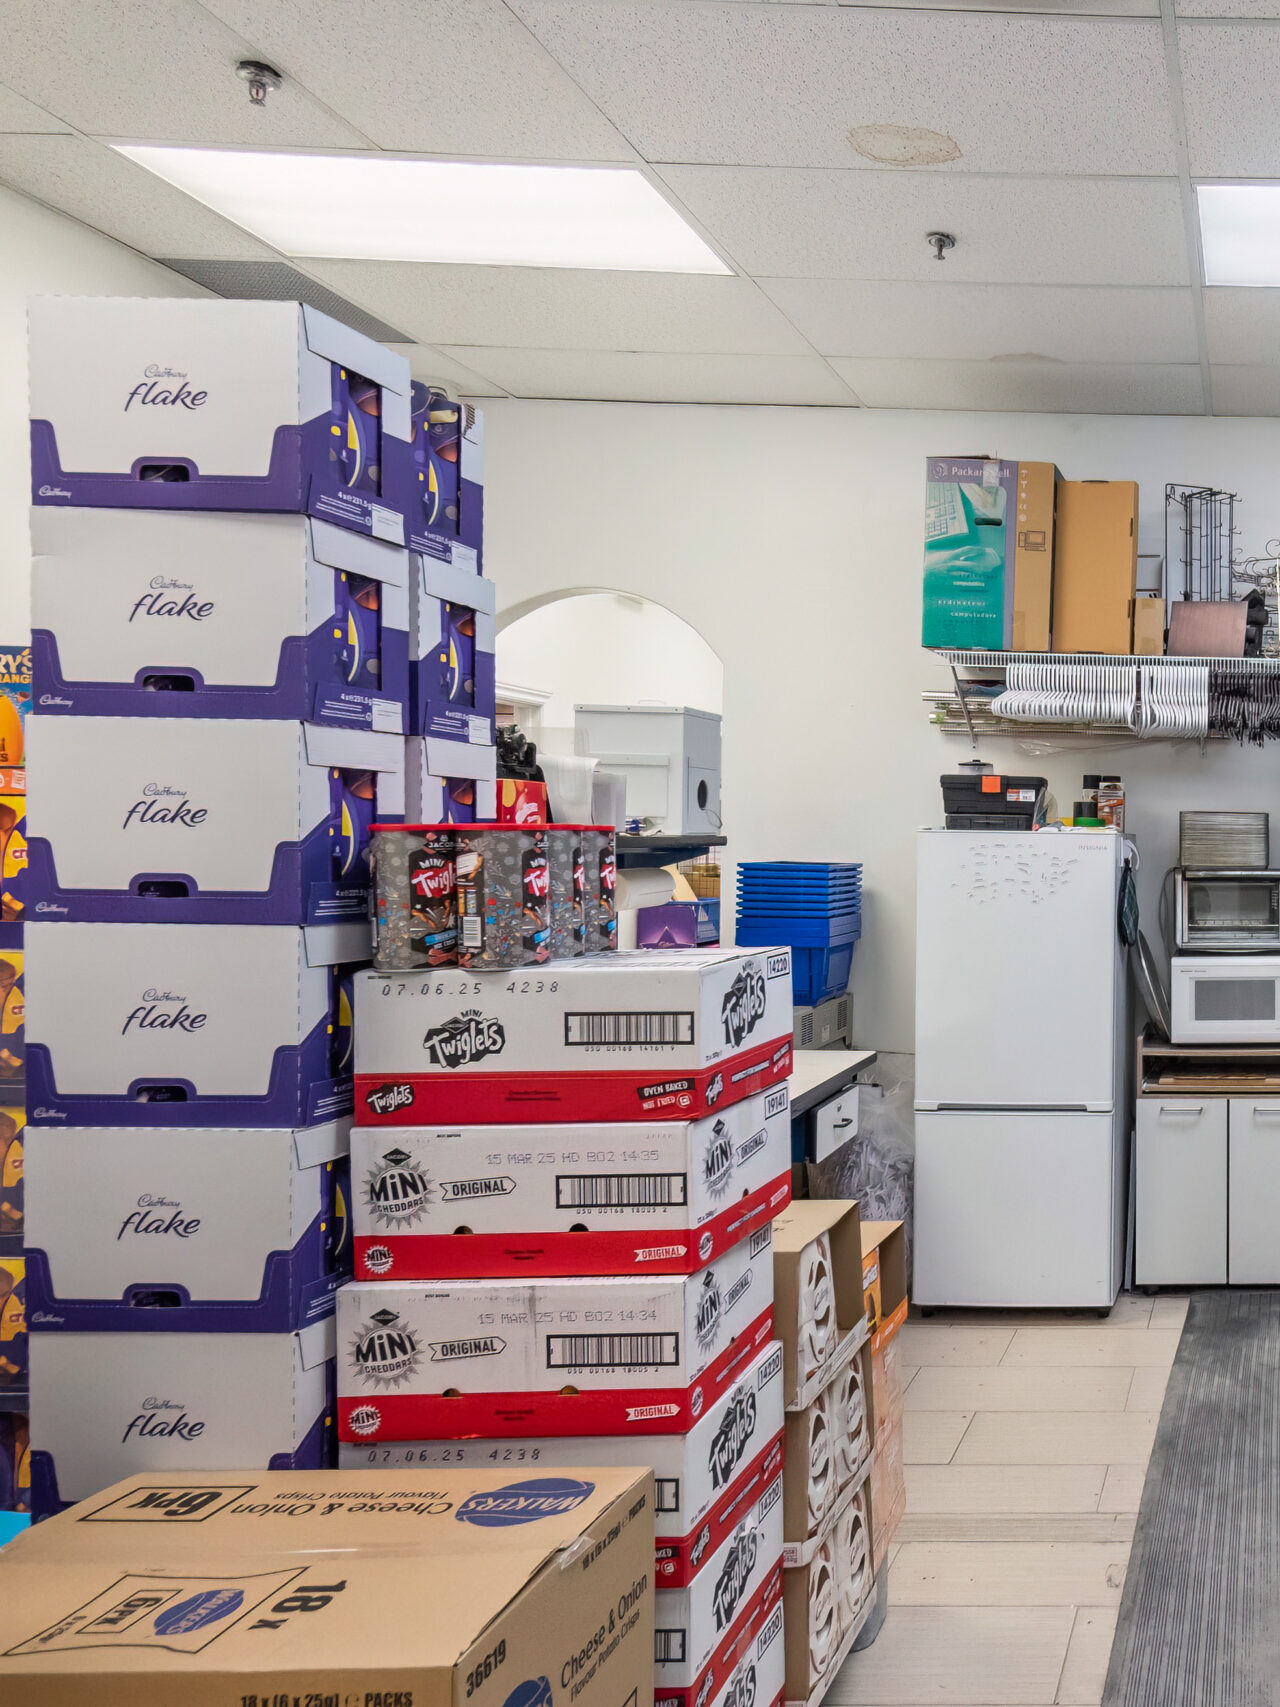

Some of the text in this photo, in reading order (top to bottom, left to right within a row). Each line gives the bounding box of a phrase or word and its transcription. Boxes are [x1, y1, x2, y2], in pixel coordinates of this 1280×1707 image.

[145, 364, 187, 379] Cadbury
[124, 381, 208, 412] flake
[952, 467, 985, 477] Packar
[150, 576, 193, 591] Cadbury
[129, 594, 214, 622] flake
[143, 783, 186, 798] Cadbury
[123, 800, 208, 829] flake
[419, 859, 446, 869] MINI
[769, 956, 788, 975] 14220
[143, 989, 186, 1004] Cadbury
[506, 981, 560, 994] 4238
[460, 1009, 483, 1018] MINI
[721, 972, 766, 1048] Twiglets
[122, 1007, 206, 1035] flake
[424, 1018, 502, 1068] Twiglets
[367, 1085, 413, 1113] Twiglets
[768, 1096, 786, 1115] 19141
[741, 1134, 764, 1160] ORIGINAL
[486, 1153, 502, 1165] 15
[508, 1153, 533, 1164] MAR
[537, 1152, 556, 1163] 25
[452, 1177, 508, 1196] ORIGINAL
[137, 1194, 180, 1209] Cadbury
[376, 1198, 425, 1214] CHEDDARS
[118, 1211, 200, 1240] flake
[752, 1227, 770, 1251] 19141
[641, 1247, 683, 1259] ORIGINAL
[477, 1313, 494, 1325] 15
[501, 1312, 528, 1324] MAR
[441, 1337, 498, 1357] ORIGINAL
[364, 1357, 412, 1375] CHEDDARS
[760, 1355, 780, 1383] 14220
[142, 1398, 184, 1412] Cadbury
[633, 1405, 675, 1418] ORIGINAL
[123, 1413, 205, 1443] flake
[709, 1391, 757, 1489] Twiglets
[367, 1449, 541, 1464] 07.06.25 4238
[273, 1492, 449, 1500] Flavour Potato Crisps
[462, 1497, 586, 1511] WALKERS
[760, 1484, 780, 1517] 14220
[230, 1502, 453, 1516] Cheese & Onion
[271, 1579, 348, 1613] 18
[561, 1574, 648, 1689] Cheese & Onion
[759, 1618, 780, 1651] 14220
[570, 1609, 641, 1703] Flavour Potato Crisps
[466, 1639, 506, 1698] 36619
[365, 1692, 413, 1707] PACKS
